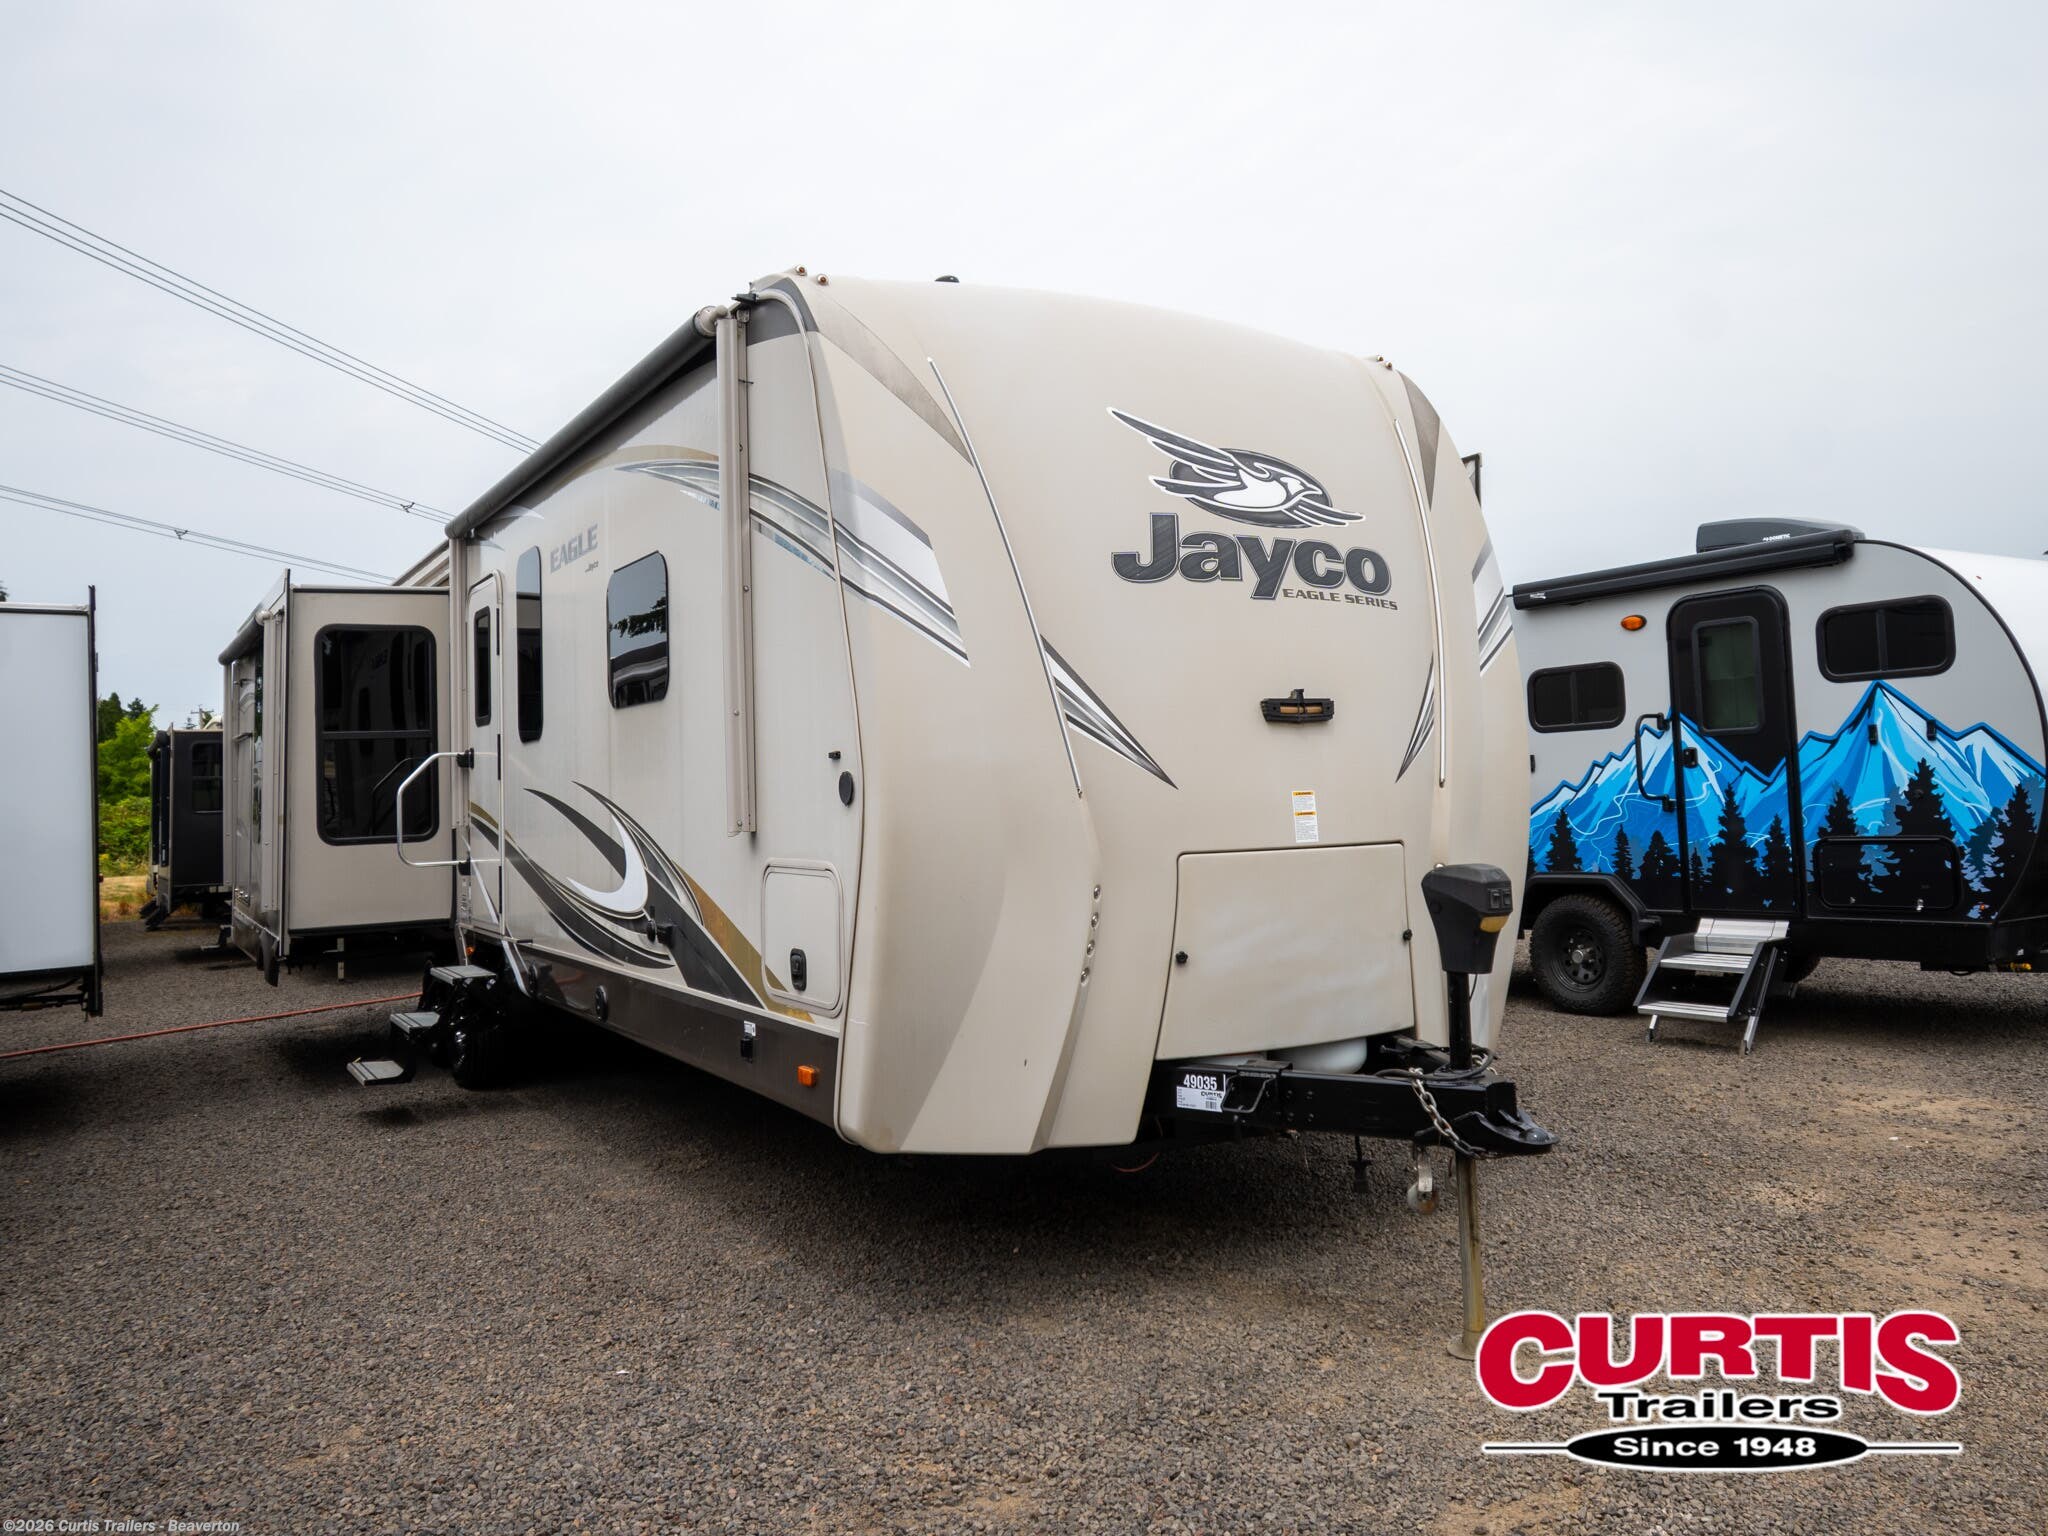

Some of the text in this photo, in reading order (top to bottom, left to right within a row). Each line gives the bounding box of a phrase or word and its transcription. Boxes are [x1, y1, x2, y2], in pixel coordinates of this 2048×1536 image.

[549, 523, 598, 574] EAGLE
[1111, 512, 1392, 600] Jayco
[1282, 588, 1398, 611] EAGLE SERIES
[1183, 1073, 1218, 1091] 49035
